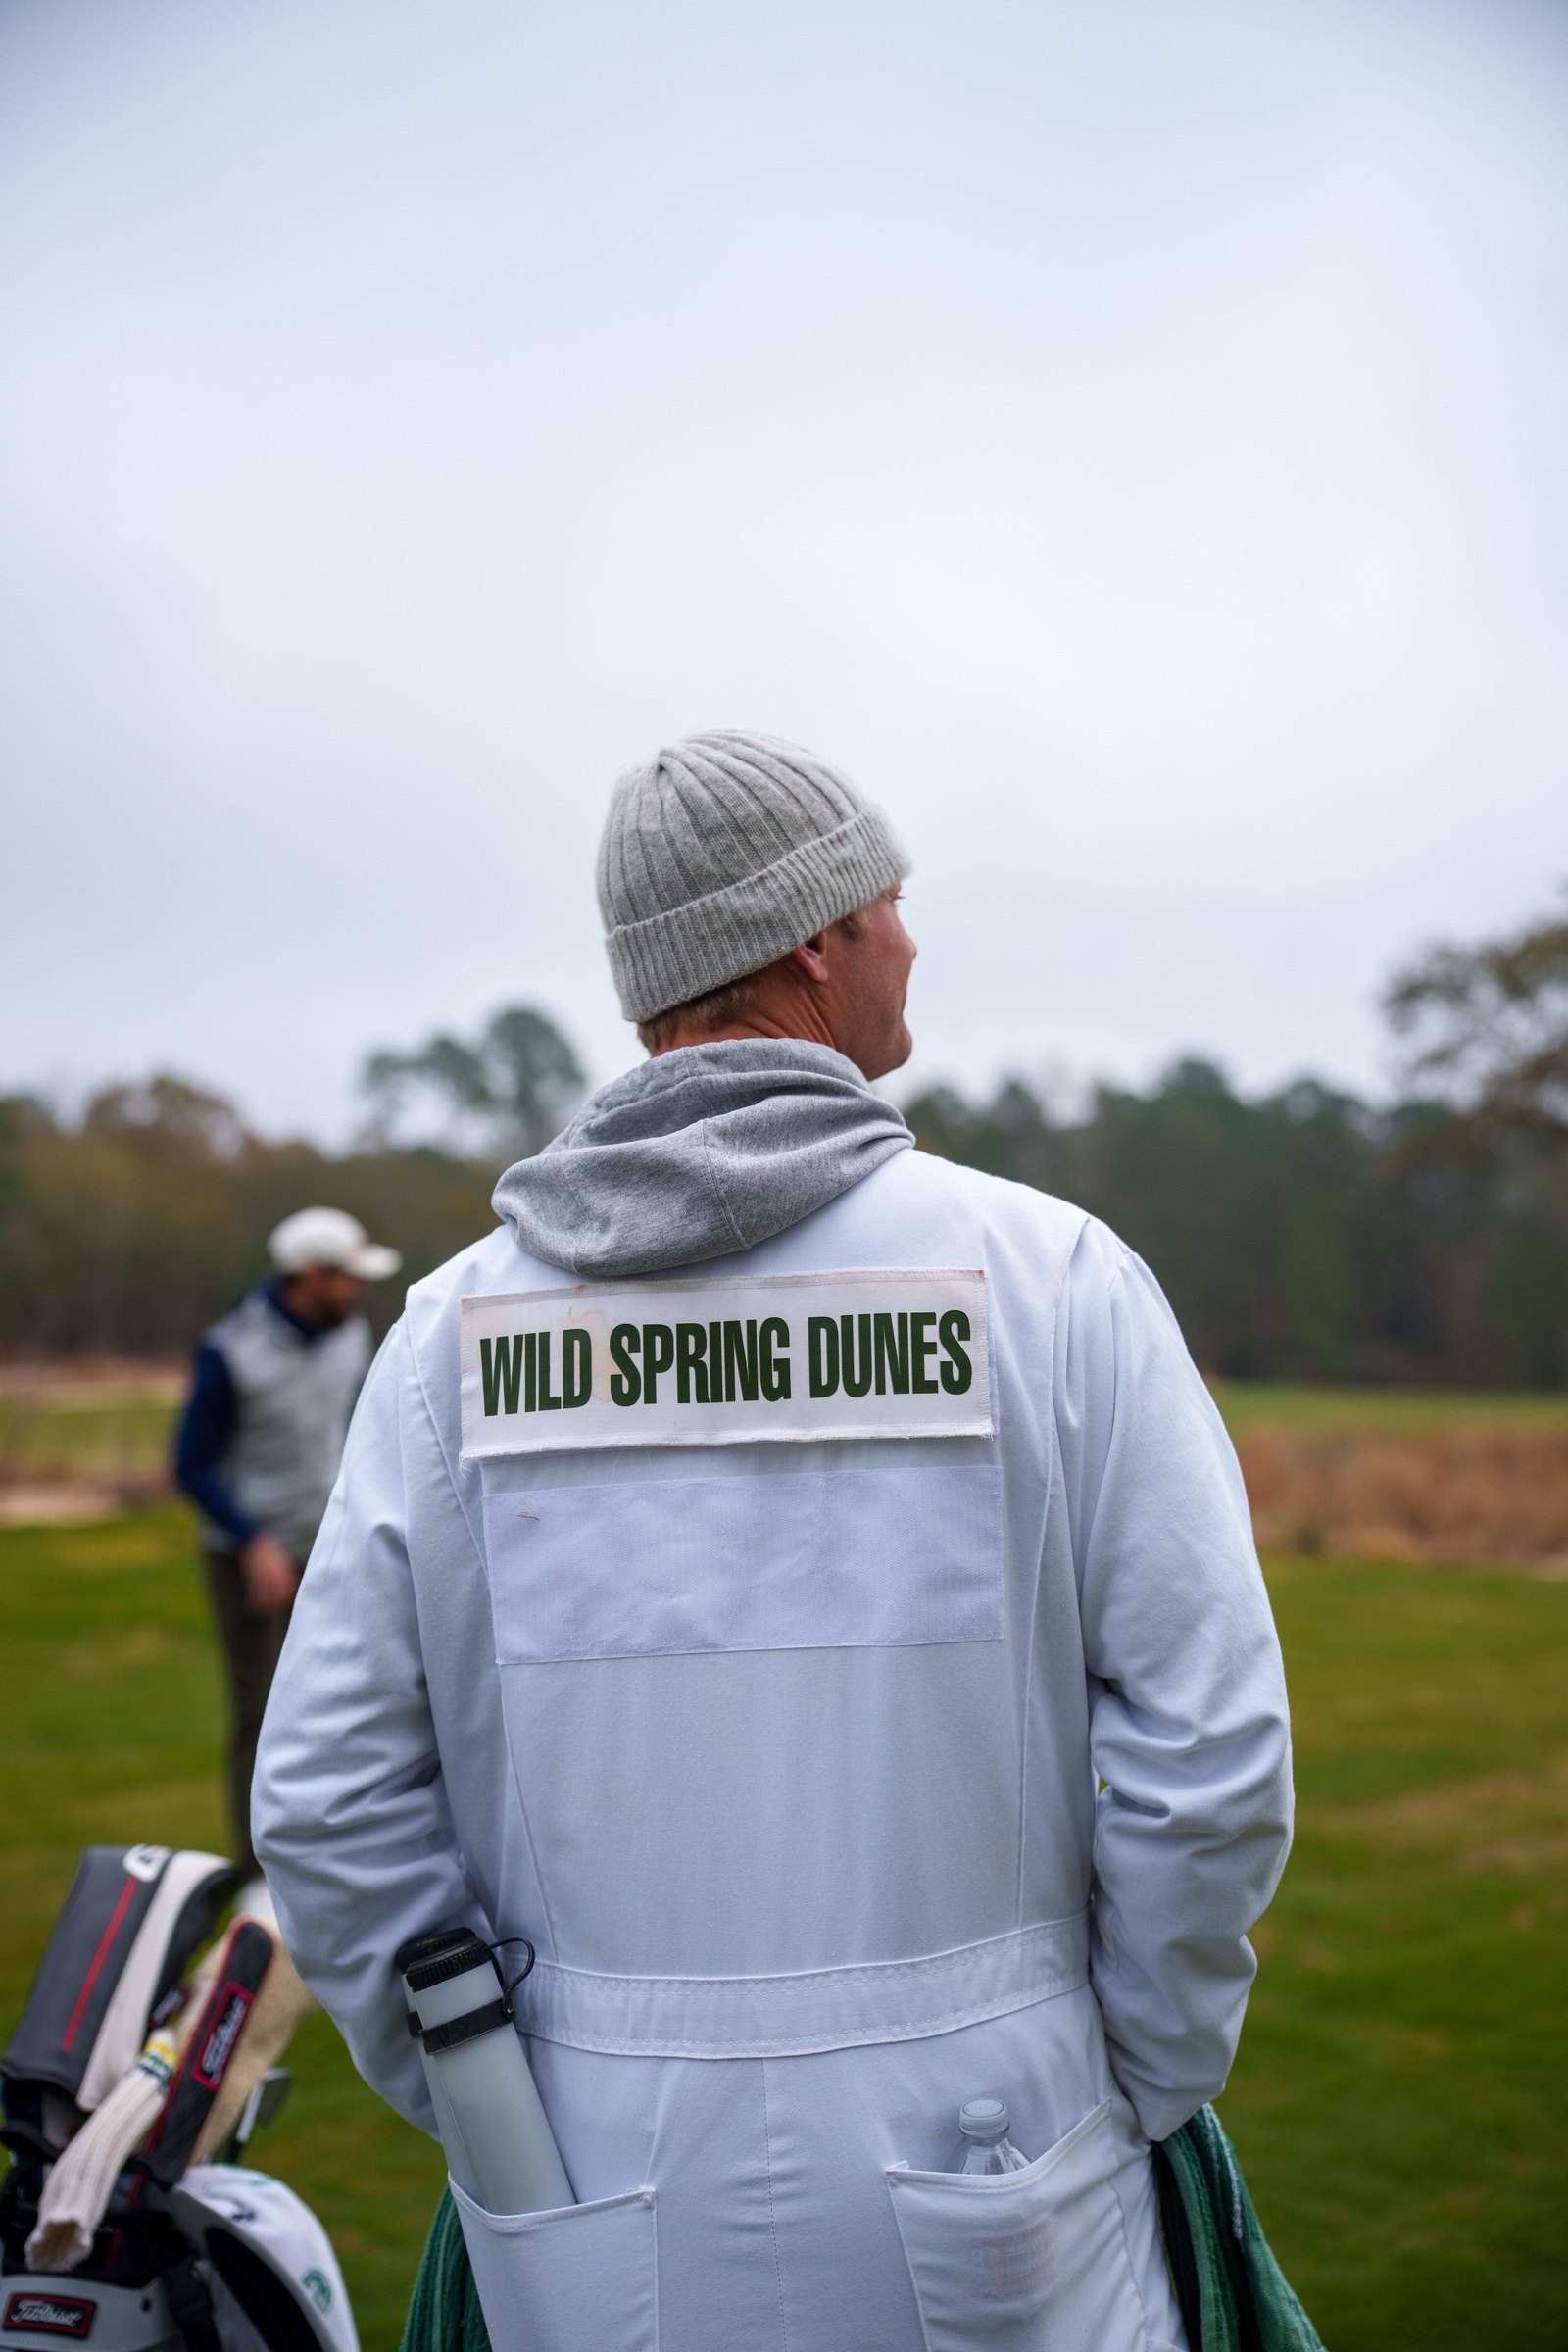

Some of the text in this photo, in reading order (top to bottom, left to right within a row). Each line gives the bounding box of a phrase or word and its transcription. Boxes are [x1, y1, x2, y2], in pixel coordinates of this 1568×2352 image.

[479, 1309, 973, 1417] WILD SPRING DUNES
